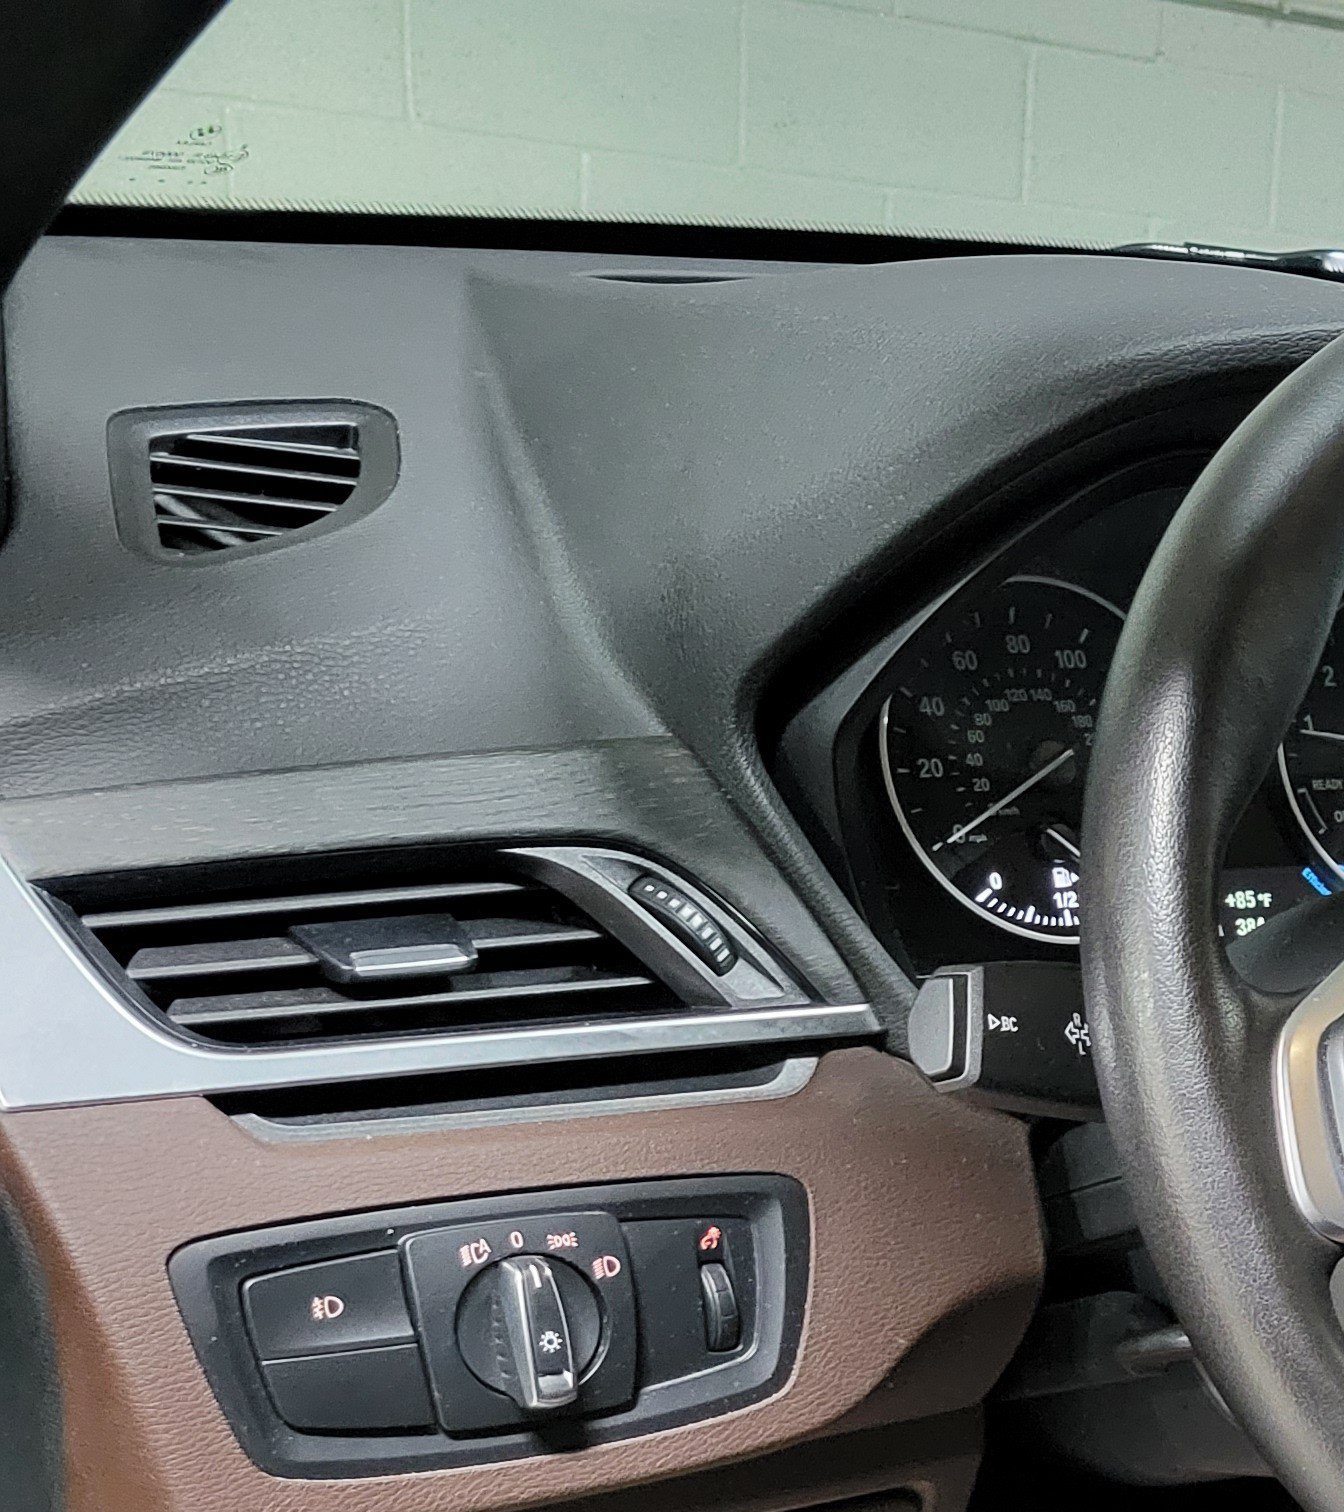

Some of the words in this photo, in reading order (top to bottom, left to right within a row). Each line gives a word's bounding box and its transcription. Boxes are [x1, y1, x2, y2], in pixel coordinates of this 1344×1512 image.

[1005, 634, 1031, 654] 80
[952, 650, 978, 670] 60
[1055, 650, 1087, 669] 100
[1322, 665, 1338, 687] 2
[1004, 688, 1028, 701] 120
[1029, 688, 1052, 701] 140
[919, 697, 945, 716] 40
[985, 698, 1010, 712] 100
[967, 730, 985, 743] 60
[917, 758, 943, 778] 20
[966, 753, 983, 766] 40
[972, 778, 990, 792] 20
[1311, 779, 1344, 791] READY
[988, 872, 1003, 890] 0
[1000, 1015, 1019, 1033] BC
